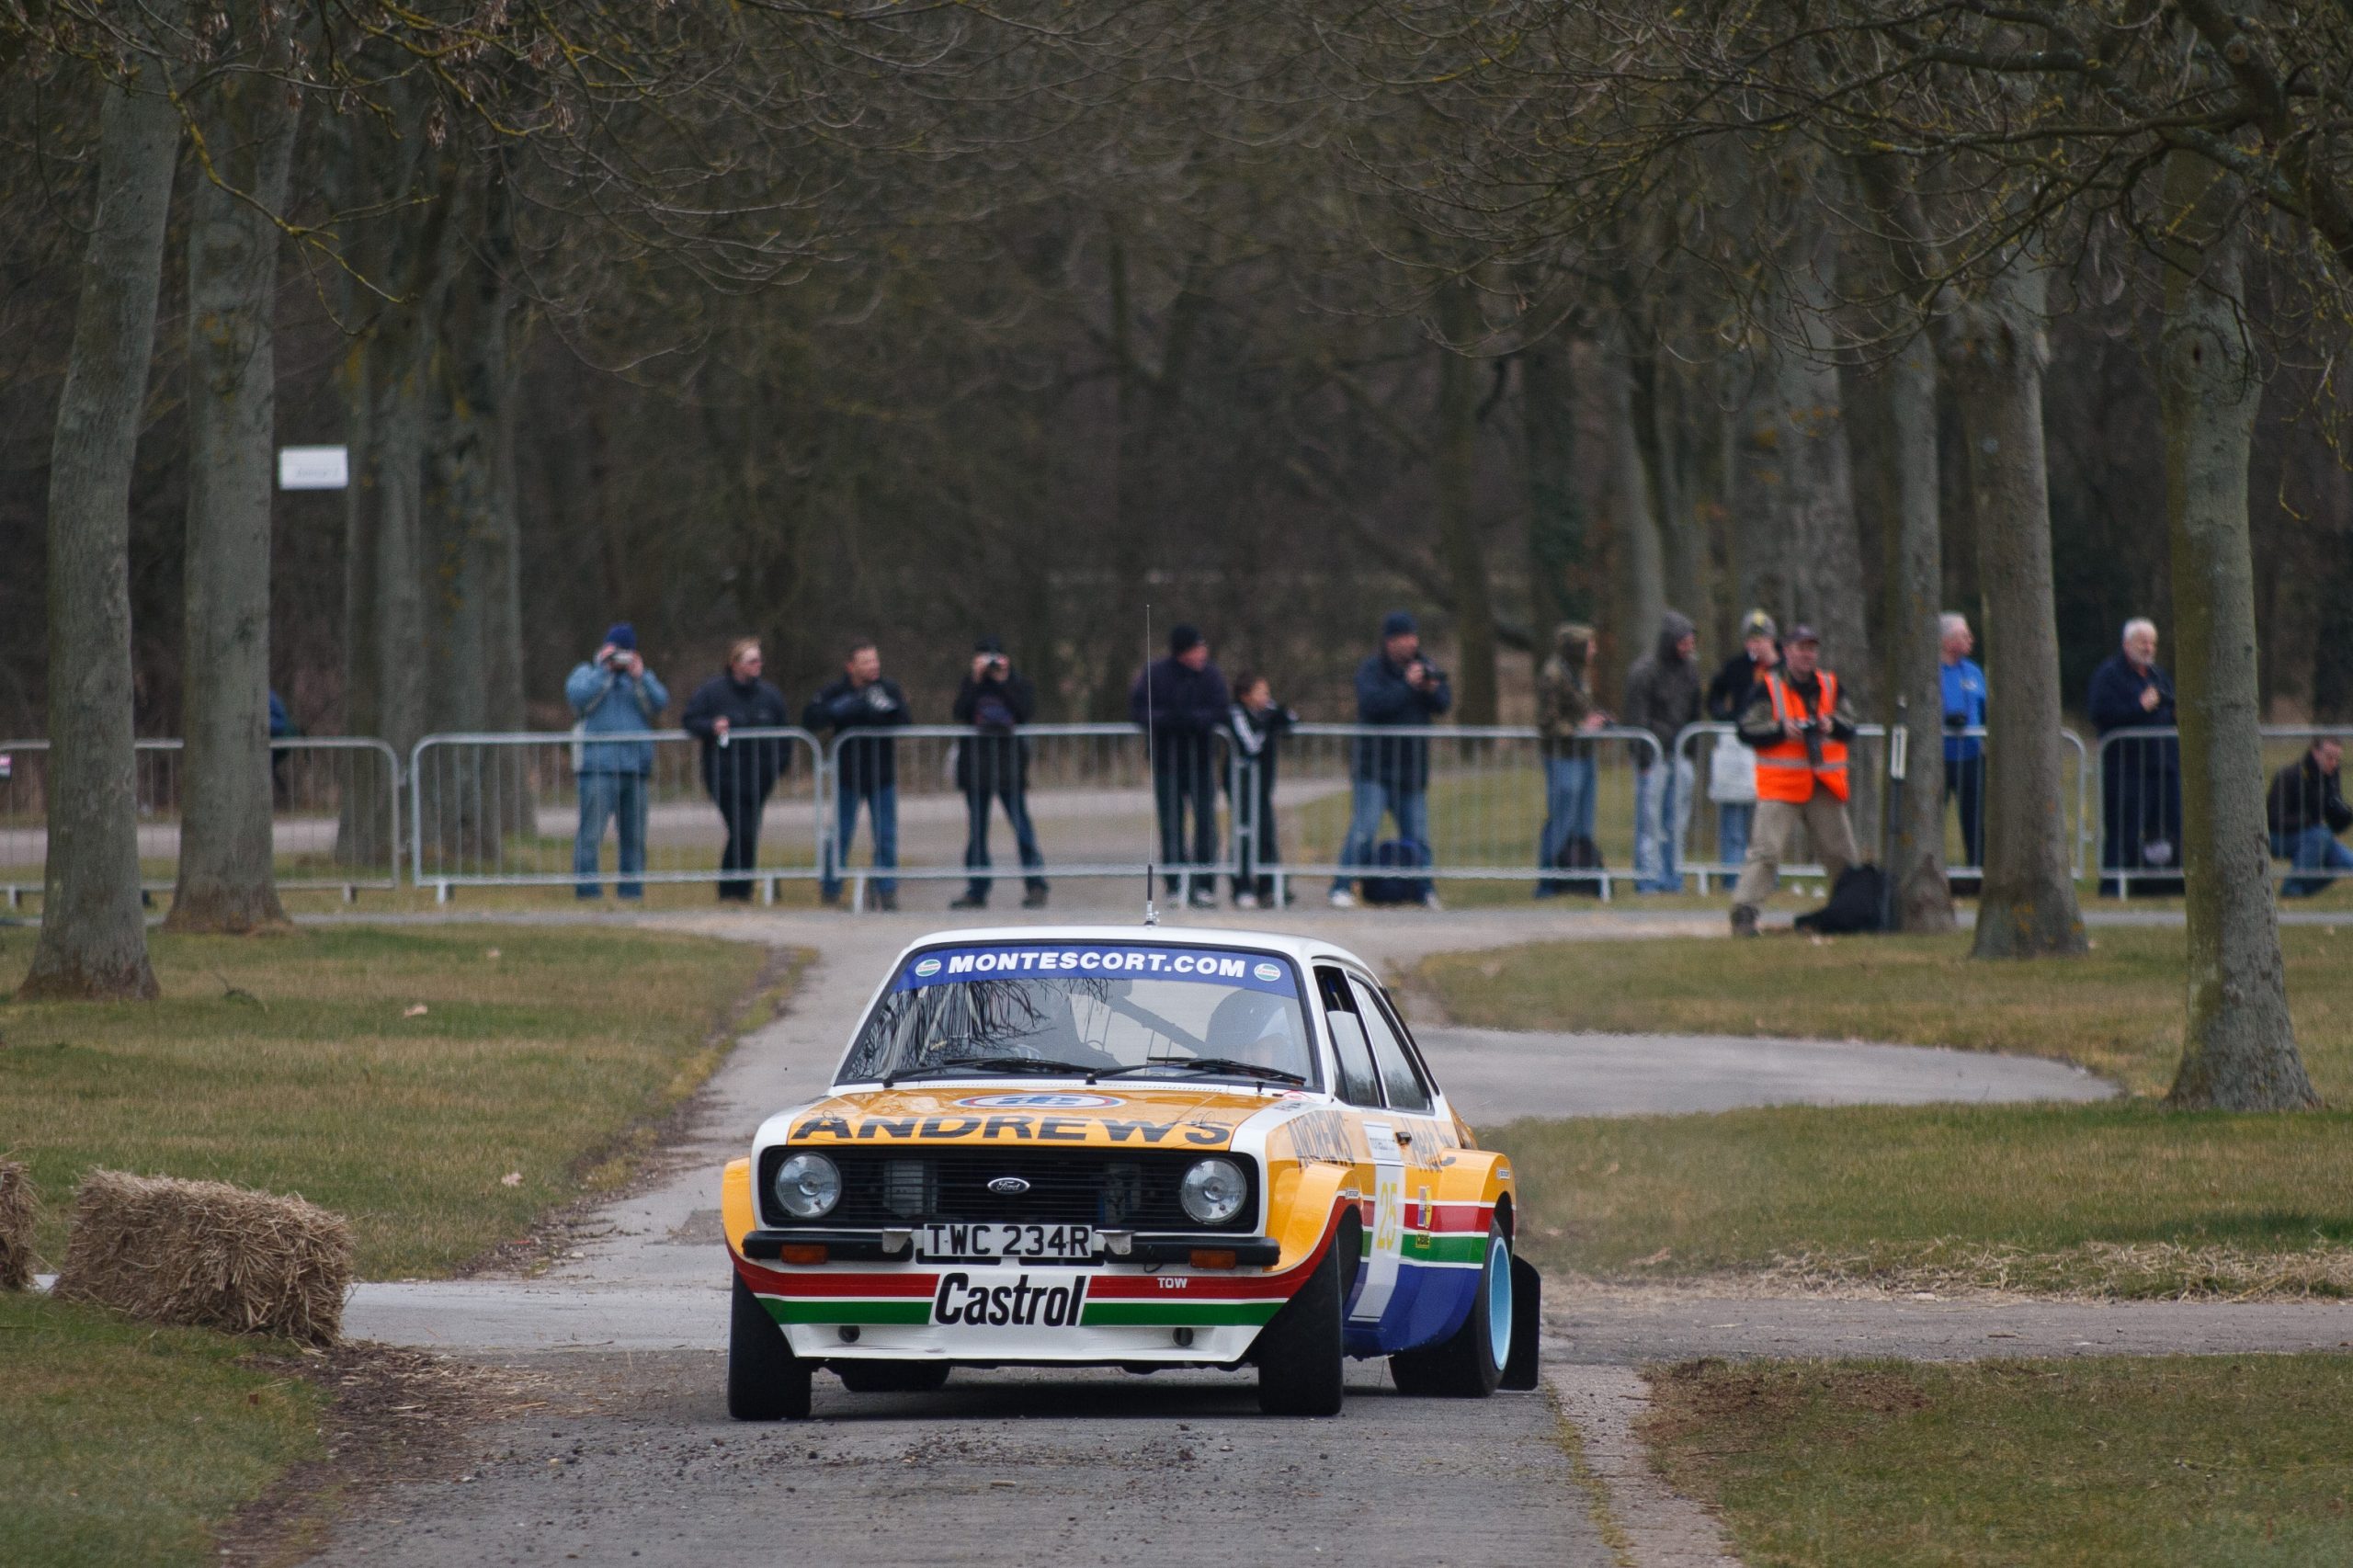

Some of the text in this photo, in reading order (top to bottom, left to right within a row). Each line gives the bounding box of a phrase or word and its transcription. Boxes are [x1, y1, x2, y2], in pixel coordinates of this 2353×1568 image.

[948, 951, 1245, 978] MONTESCORT.COM
[790, 1115, 1233, 1145] ANDREWS
[1377, 1182, 1397, 1250] 25
[926, 1224, 1089, 1256] TWC 234R
[935, 1272, 1087, 1326] Castrol
[1157, 1278, 1188, 1289] TOW
